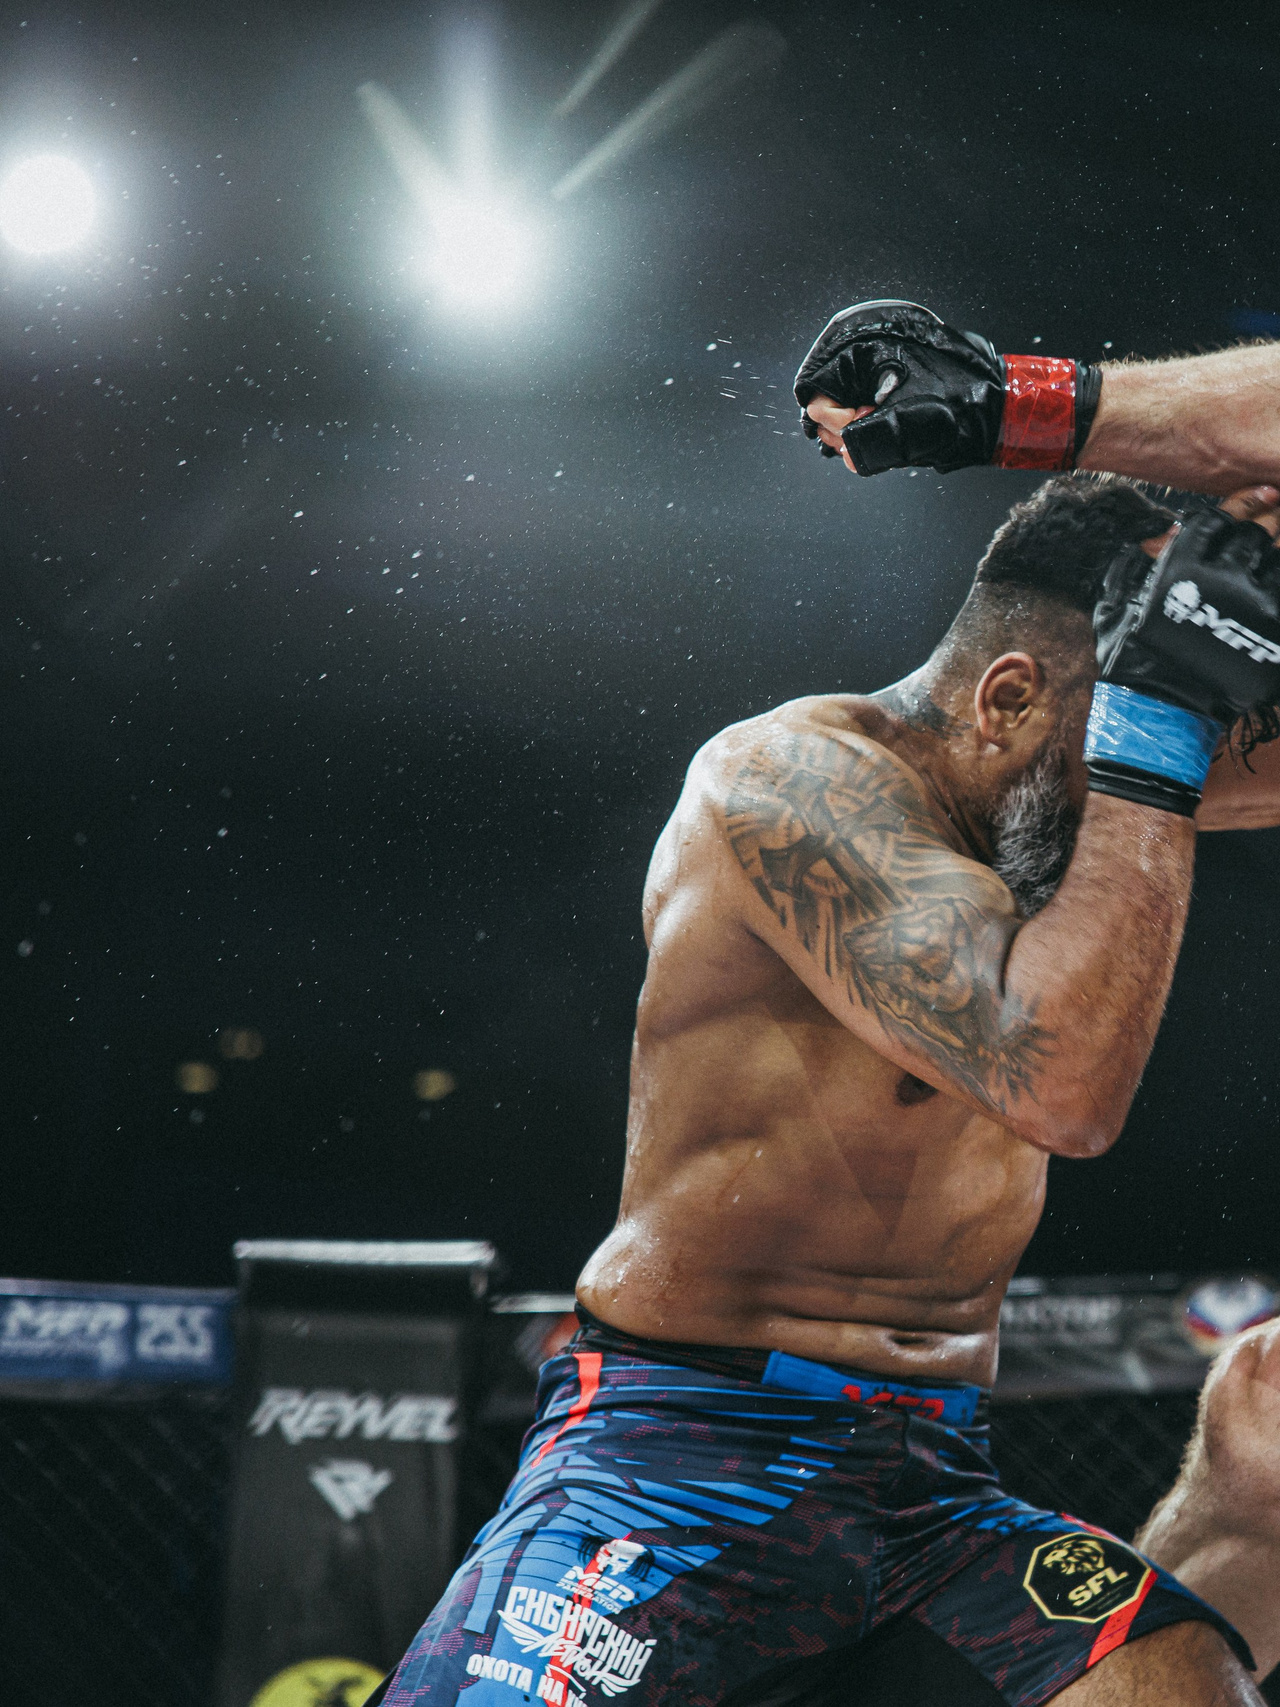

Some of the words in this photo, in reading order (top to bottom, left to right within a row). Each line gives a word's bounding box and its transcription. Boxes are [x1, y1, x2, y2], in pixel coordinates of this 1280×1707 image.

[563, 1565, 635, 1602] MFP
[1068, 1566, 1129, 1607] SFL
[503, 1586, 658, 1681] СИБИРСКИЙ
[466, 1653, 534, 1693] ОХОТА
[536, 1674, 565, 1707] НА
